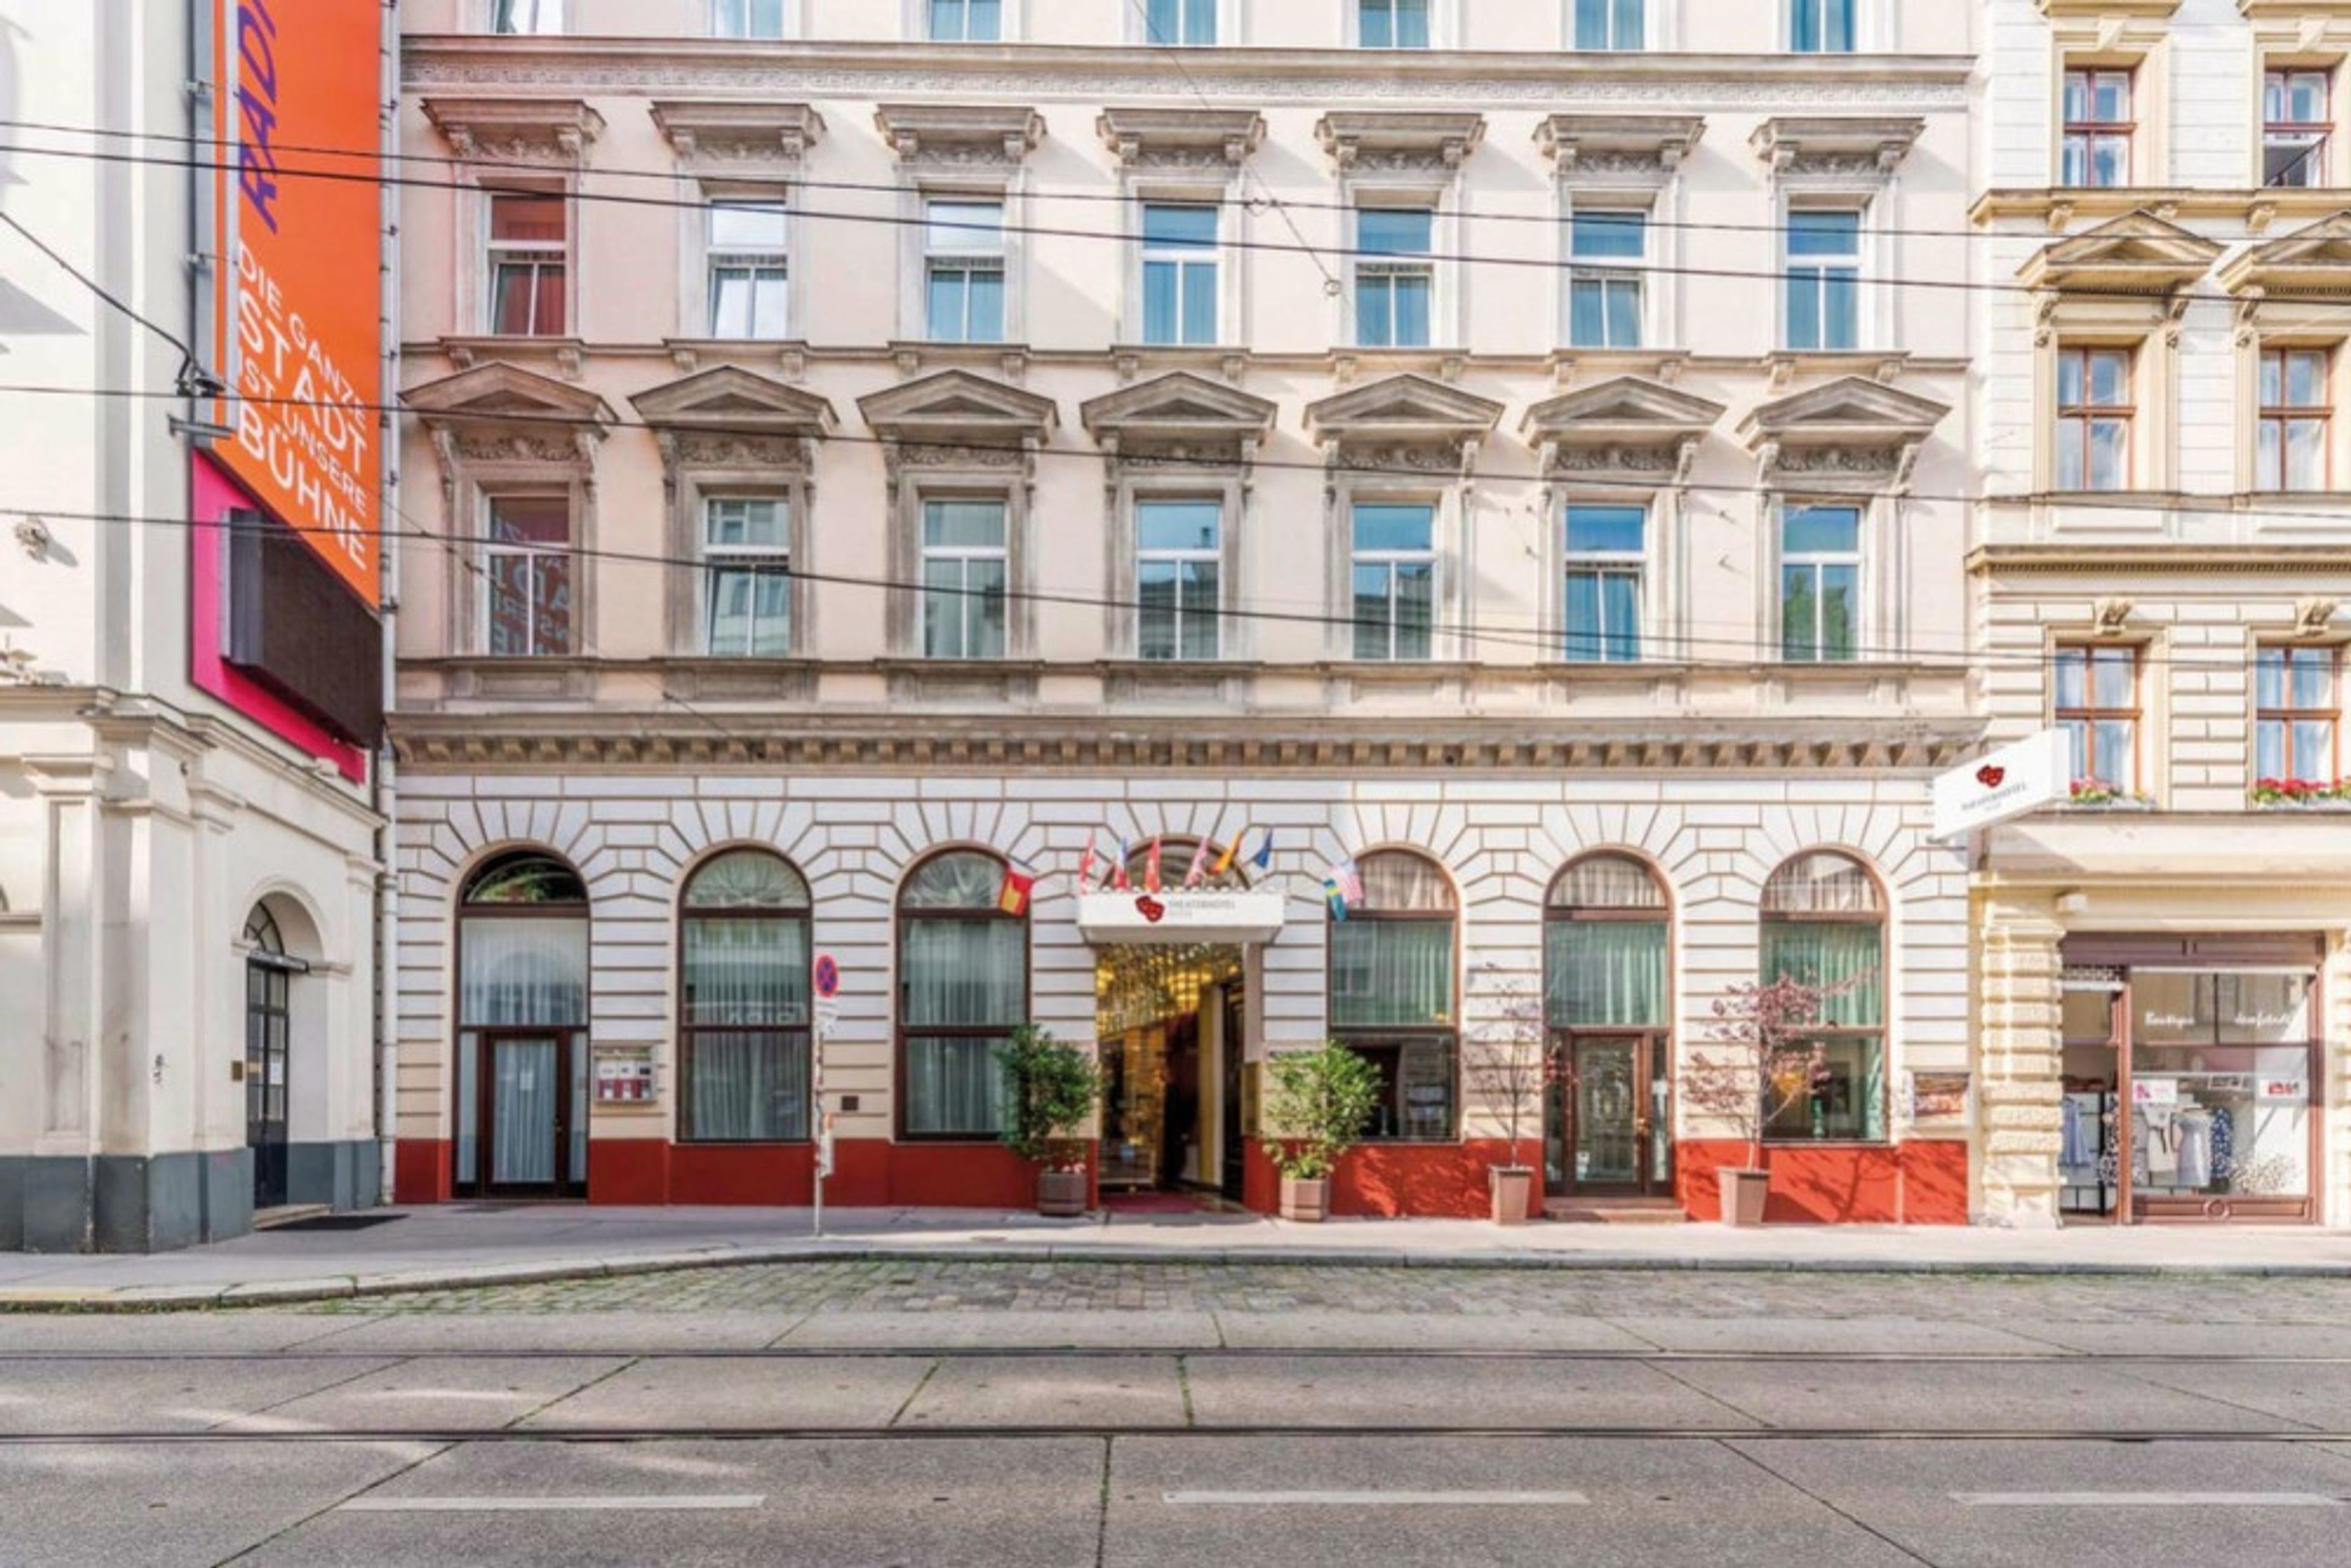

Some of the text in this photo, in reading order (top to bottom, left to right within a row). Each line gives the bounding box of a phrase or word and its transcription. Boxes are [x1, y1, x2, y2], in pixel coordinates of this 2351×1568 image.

[239, 239, 366, 431] DIE GANZE
[239, 290, 367, 476] STADT
[239, 398, 366, 571] BÜHNE
[282, 399, 367, 518] UNSERE
